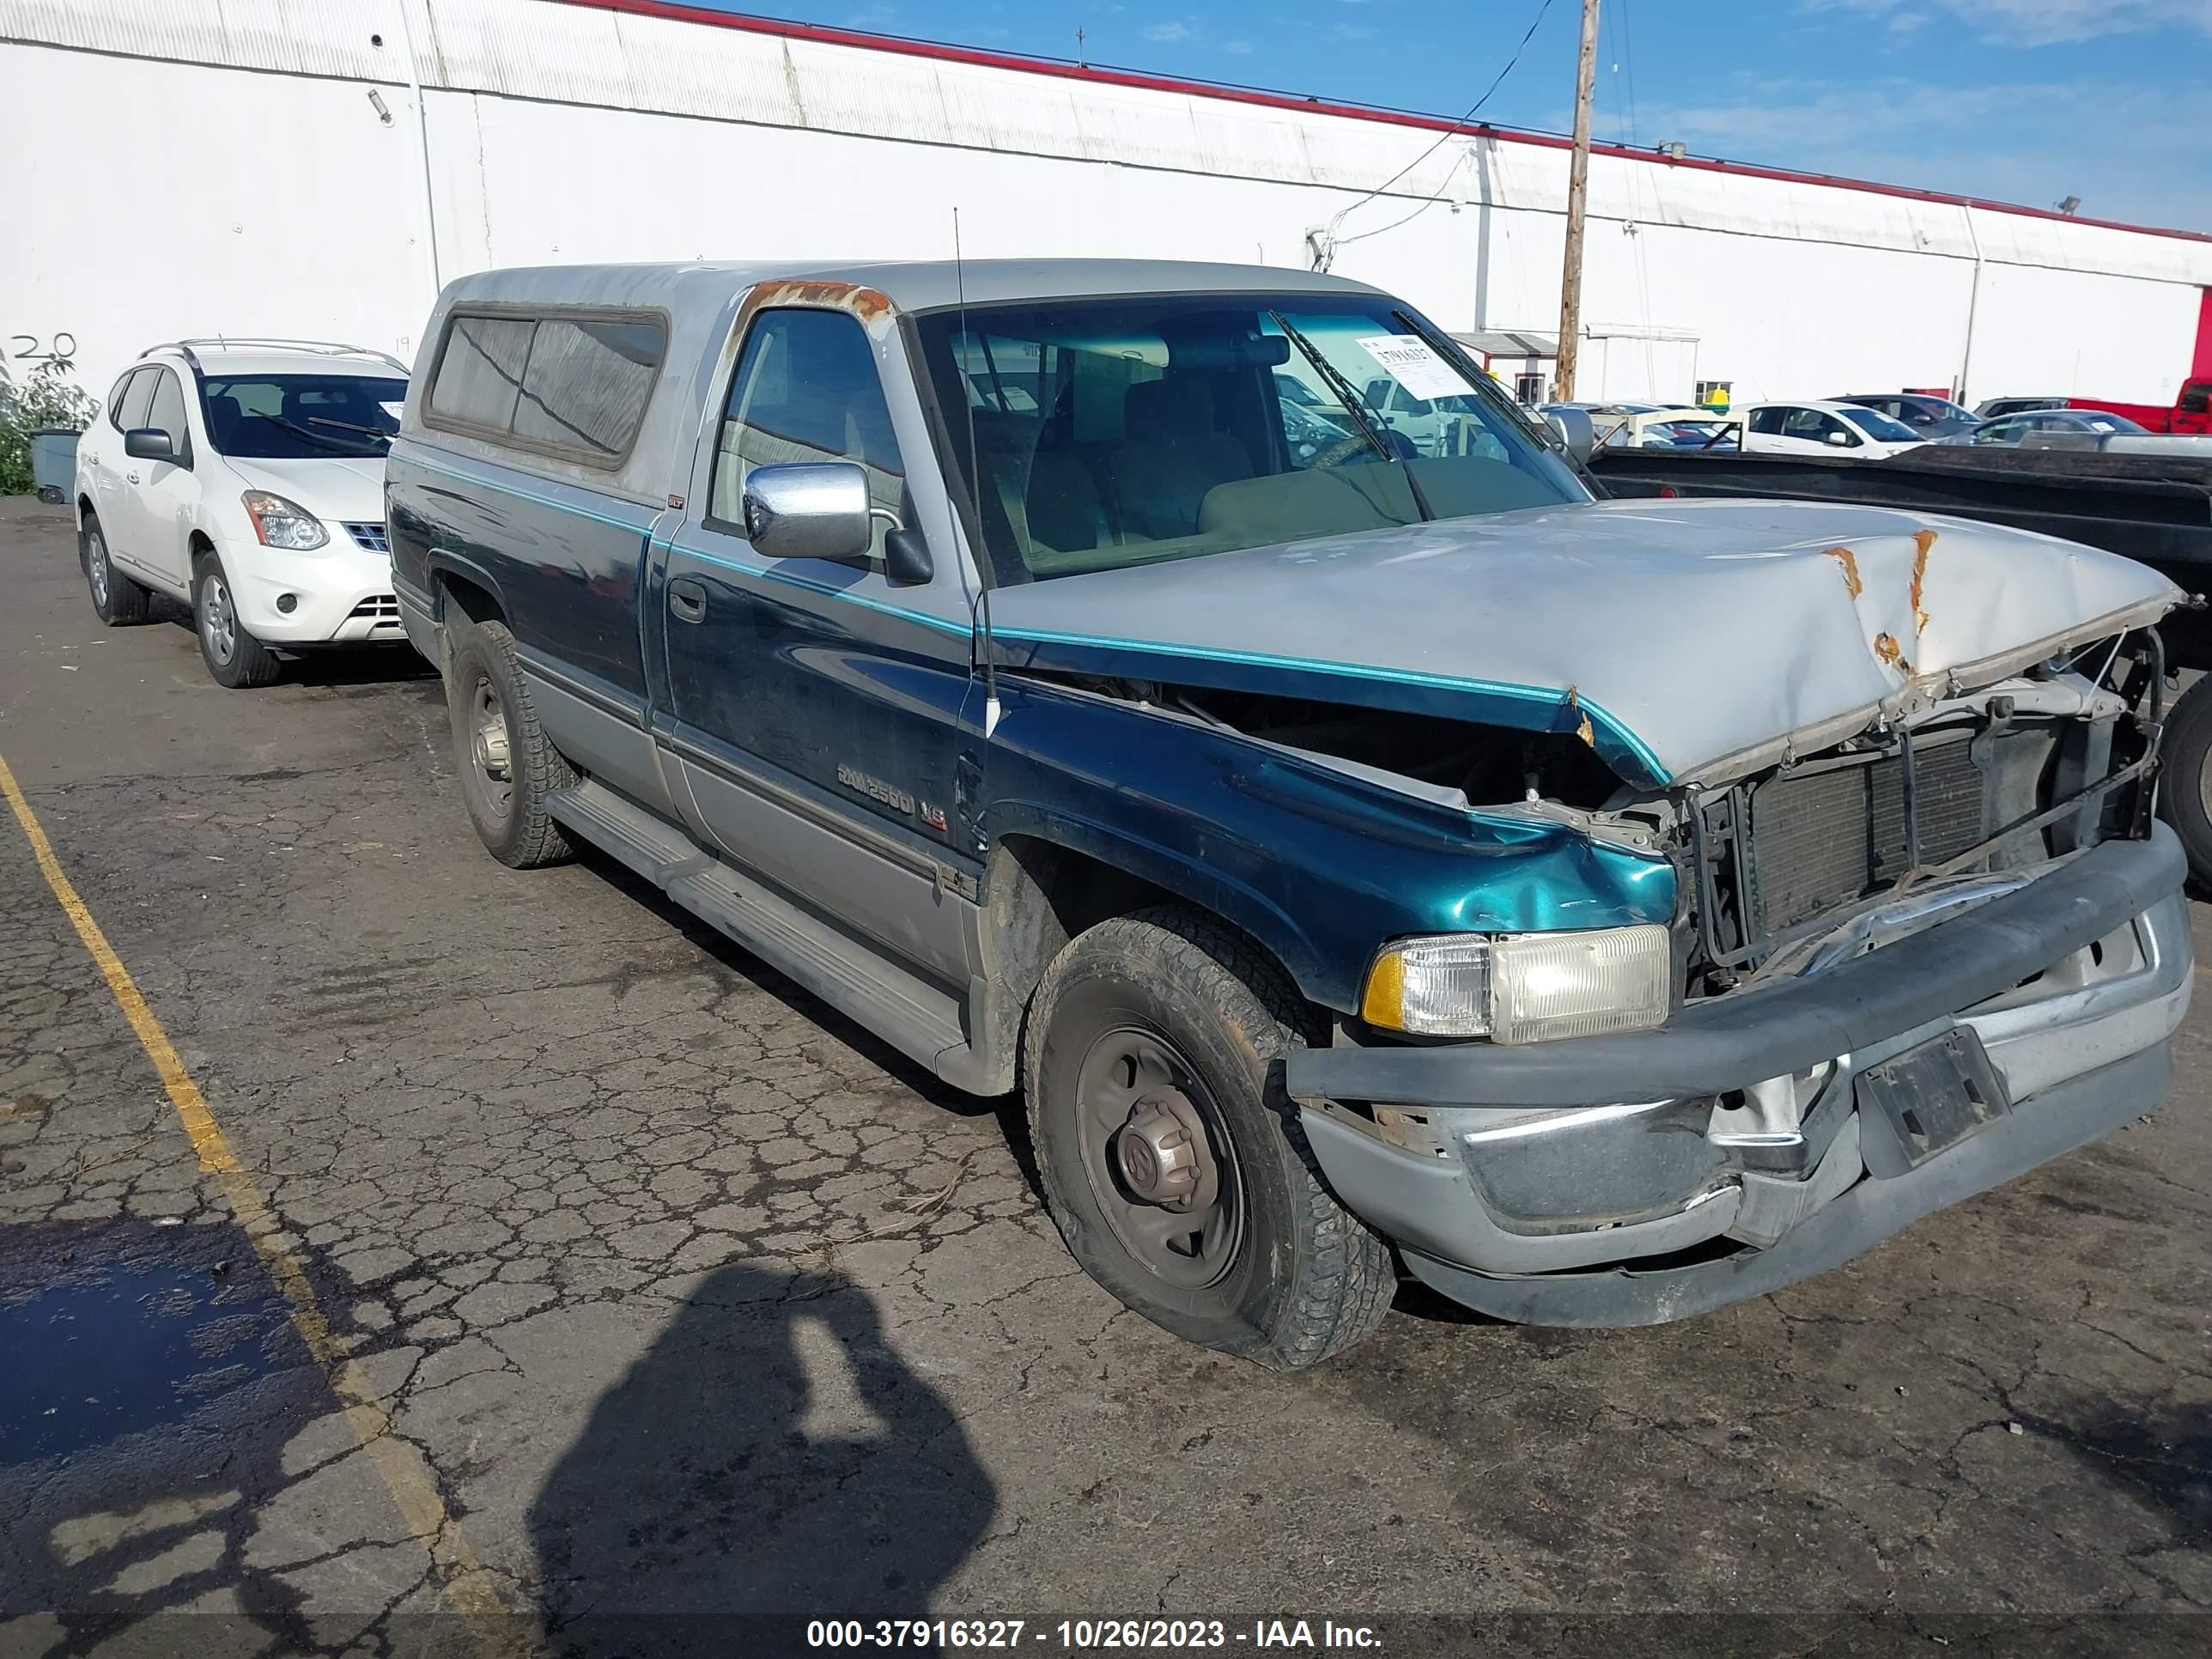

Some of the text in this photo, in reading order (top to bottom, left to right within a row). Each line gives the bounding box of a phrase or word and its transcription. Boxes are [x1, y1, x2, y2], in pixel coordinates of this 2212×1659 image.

[11, 332, 76, 358] 20
[396, 337, 410, 352] 19
[1377, 348, 1432, 364] 37916327
[668, 498, 683, 508] SLT
[837, 763, 915, 816] RAM 2500
